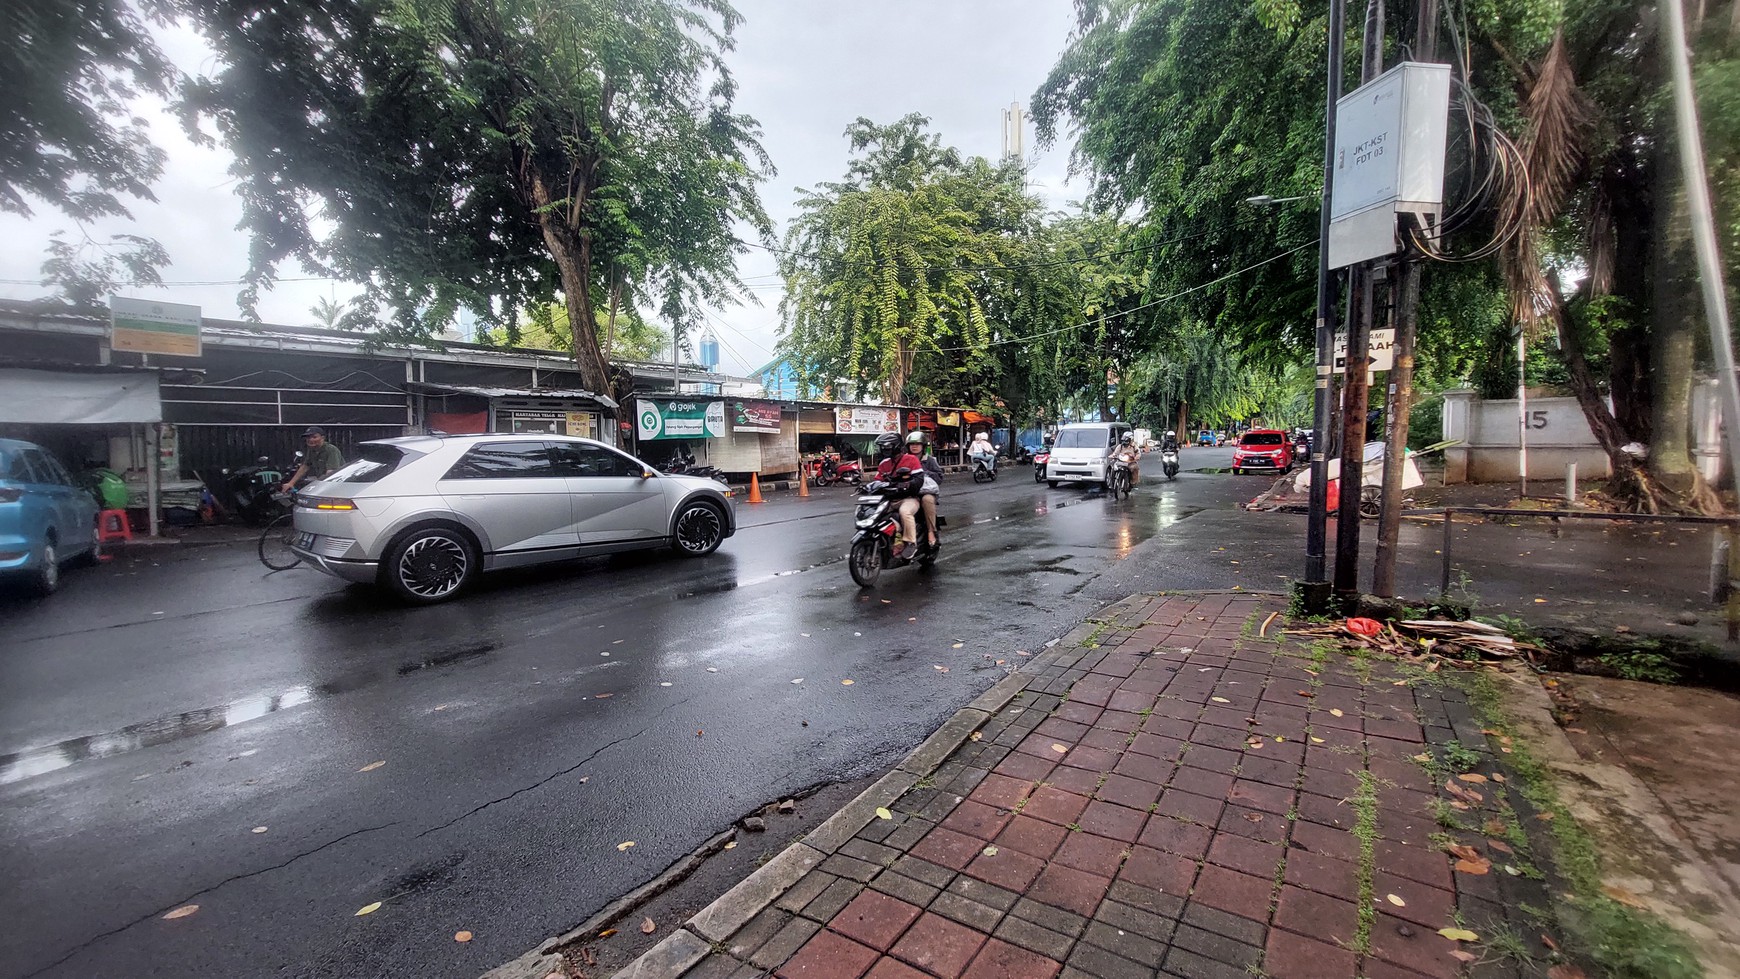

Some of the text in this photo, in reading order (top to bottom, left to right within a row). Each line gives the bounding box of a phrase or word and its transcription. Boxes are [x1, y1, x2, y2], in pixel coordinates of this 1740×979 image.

[1353, 131, 1388, 156] JKT-KST
[1356, 151, 1373, 166] FDT
[1373, 146, 1384, 158] 03
